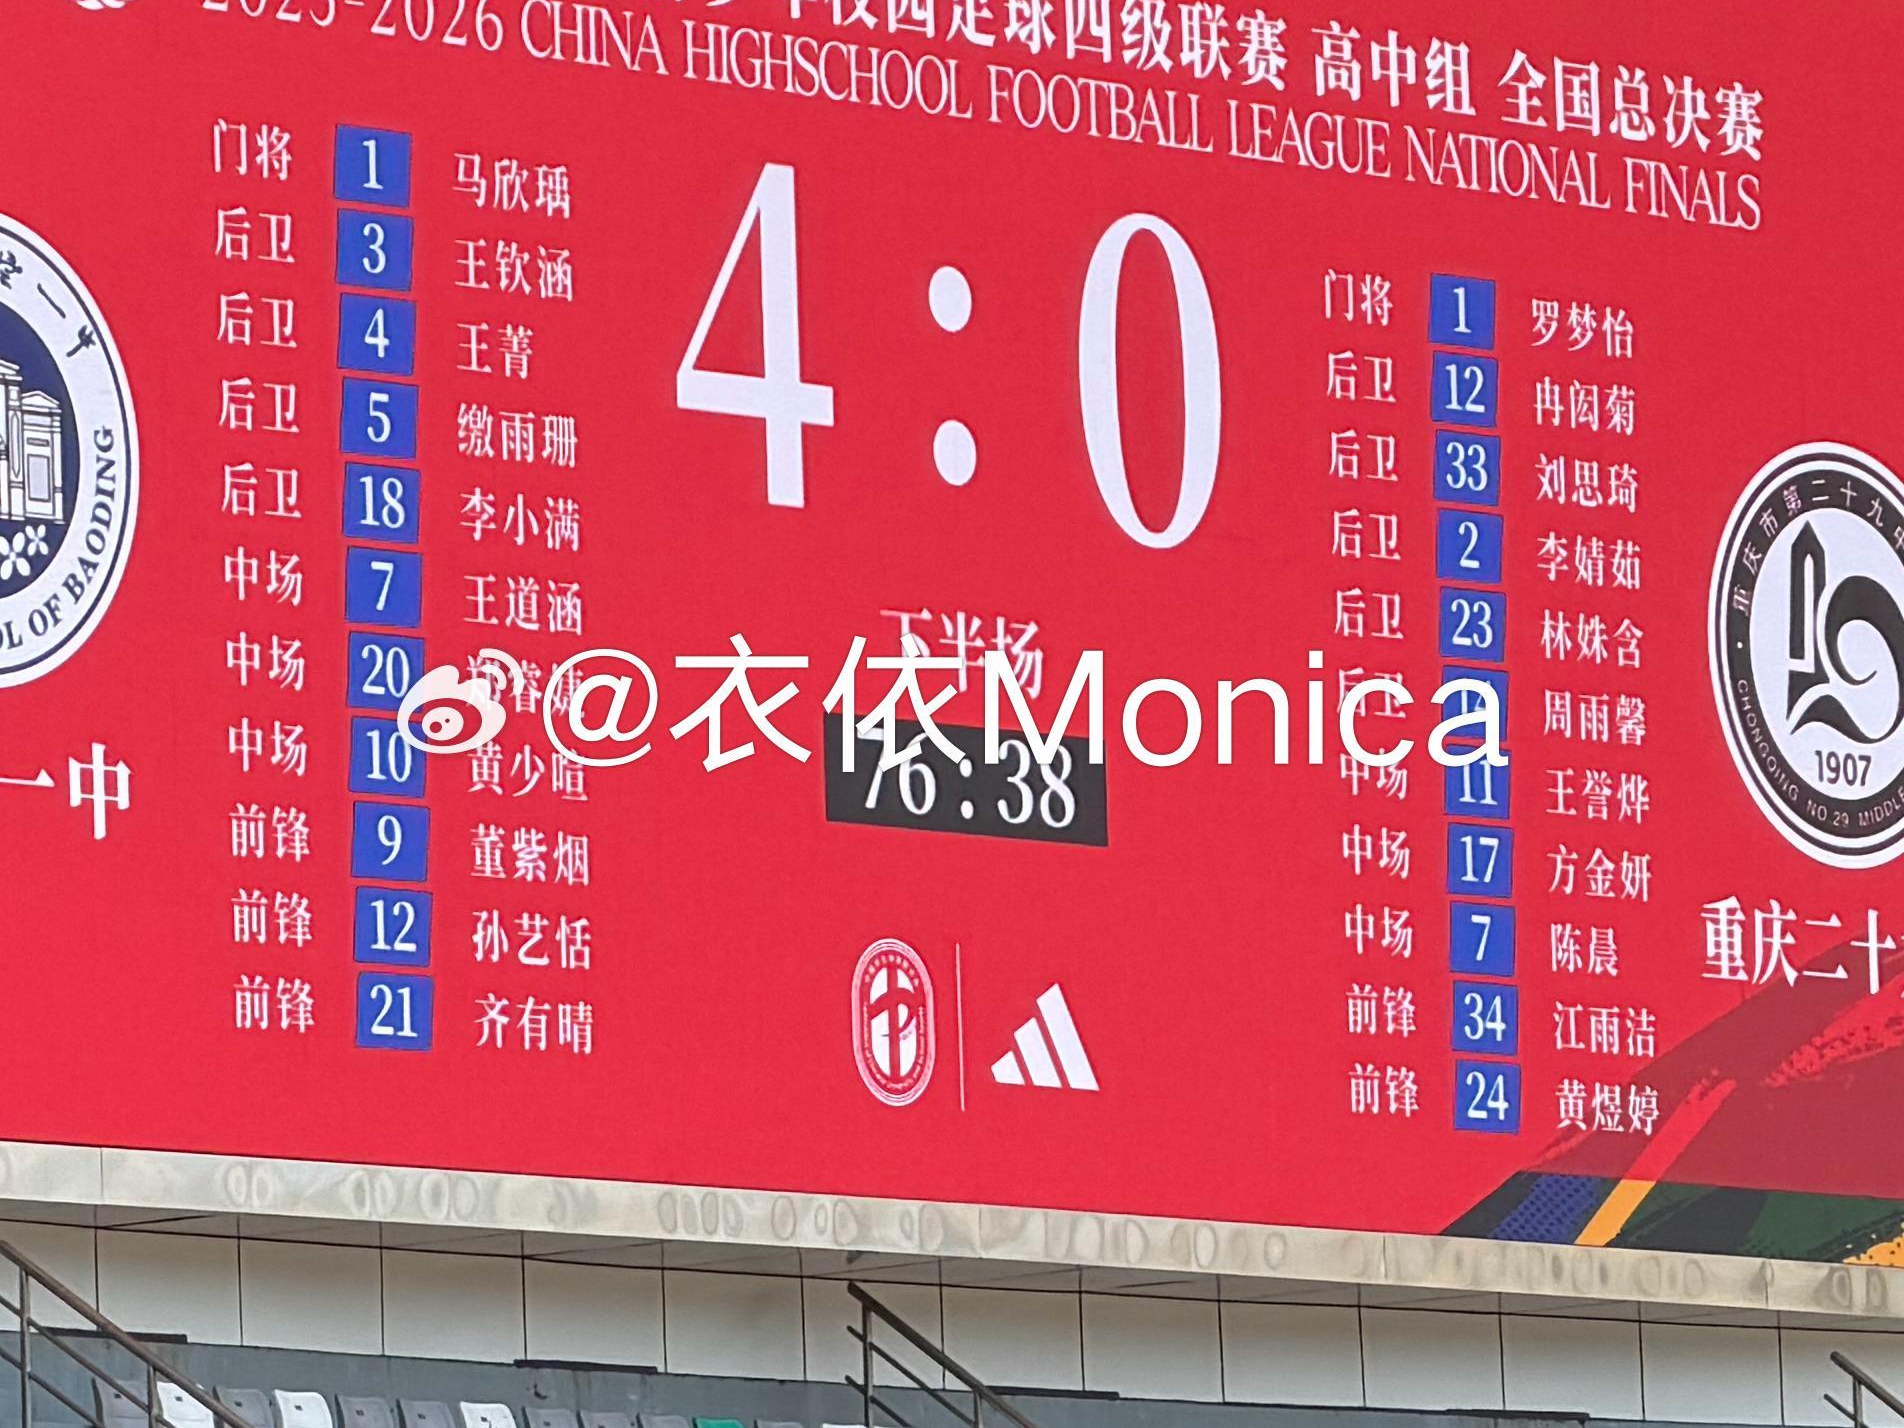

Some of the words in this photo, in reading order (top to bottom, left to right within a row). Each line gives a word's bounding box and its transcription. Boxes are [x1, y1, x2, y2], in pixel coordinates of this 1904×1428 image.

[683, 18, 973, 120] HIGHSCHOOL
[986, 64, 1213, 153] FOOTBALL
[1227, 99, 1392, 178] LEAGUE
[1403, 125, 1611, 210] NATIONAL
[1623, 156, 1761, 231] FINALS
[1311, 20, 1477, 117] 高中组
[1498, 49, 1764, 161] 全国总决赛
[214, 119, 291, 180] 门将
[363, 140, 382, 189] 1
[216, 207, 294, 262] 后卫
[363, 223, 385, 273] 3
[456, 239, 572, 301] 王钦涵
[218, 292, 296, 347] 后卫
[365, 309, 389, 357] 4
[1325, 269, 1392, 326] 门将
[1454, 287, 1471, 332] 1
[1532, 299, 1633, 358] 罗梦怡
[220, 378, 299, 432] 后卫
[368, 392, 390, 442] 5
[1327, 351, 1395, 402] 后卫
[1446, 364, 1485, 412] 12
[222, 463, 301, 517] 后卫
[360, 476, 404, 528] 18
[461, 488, 579, 551] 李小满
[1330, 430, 1397, 481] 后卫
[1447, 442, 1487, 491] 33
[1536, 454, 1637, 512] 刘思琦
[28, 593, 63, 637] OF
[62, 425, 116, 604] BAODING
[1332, 509, 1400, 560] 后卫
[1459, 522, 1479, 568] 2
[225, 547, 302, 605] 中场
[371, 561, 393, 610] 7
[465, 575, 581, 635] 王道涵
[1335, 588, 1403, 638] 后卫
[1451, 599, 1492, 648] 23
[227, 632, 304, 690] 中场
[362, 645, 410, 698] 20
[229, 718, 307, 776] 中场
[367, 729, 412, 782] 10
[857, 727, 1076, 829] 76:38
[1815, 750, 1872, 787] 1907
[230, 804, 309, 861] 前锋
[378, 816, 401, 865] 9
[473, 824, 588, 885] 董紫烟
[1343, 824, 1409, 878] 中场
[1461, 836, 1498, 882] 17
[1548, 844, 1651, 902] 方金妍
[232, 889, 312, 947] 前锋
[371, 900, 416, 951] 12
[1345, 904, 1412, 958] 中场
[1471, 915, 1490, 960] 7
[1551, 924, 1617, 976] 陈晨
[236, 975, 314, 1032] 前锋
[371, 985, 417, 1037] 21
[476, 993, 592, 1054] 齐有晴
[1348, 984, 1416, 1037] 前锋
[1465, 993, 1506, 1041] 34
[1553, 1002, 1655, 1057] 江雨洁
[1351, 1064, 1418, 1116] 前锋
[1466, 1072, 1508, 1120] 24
